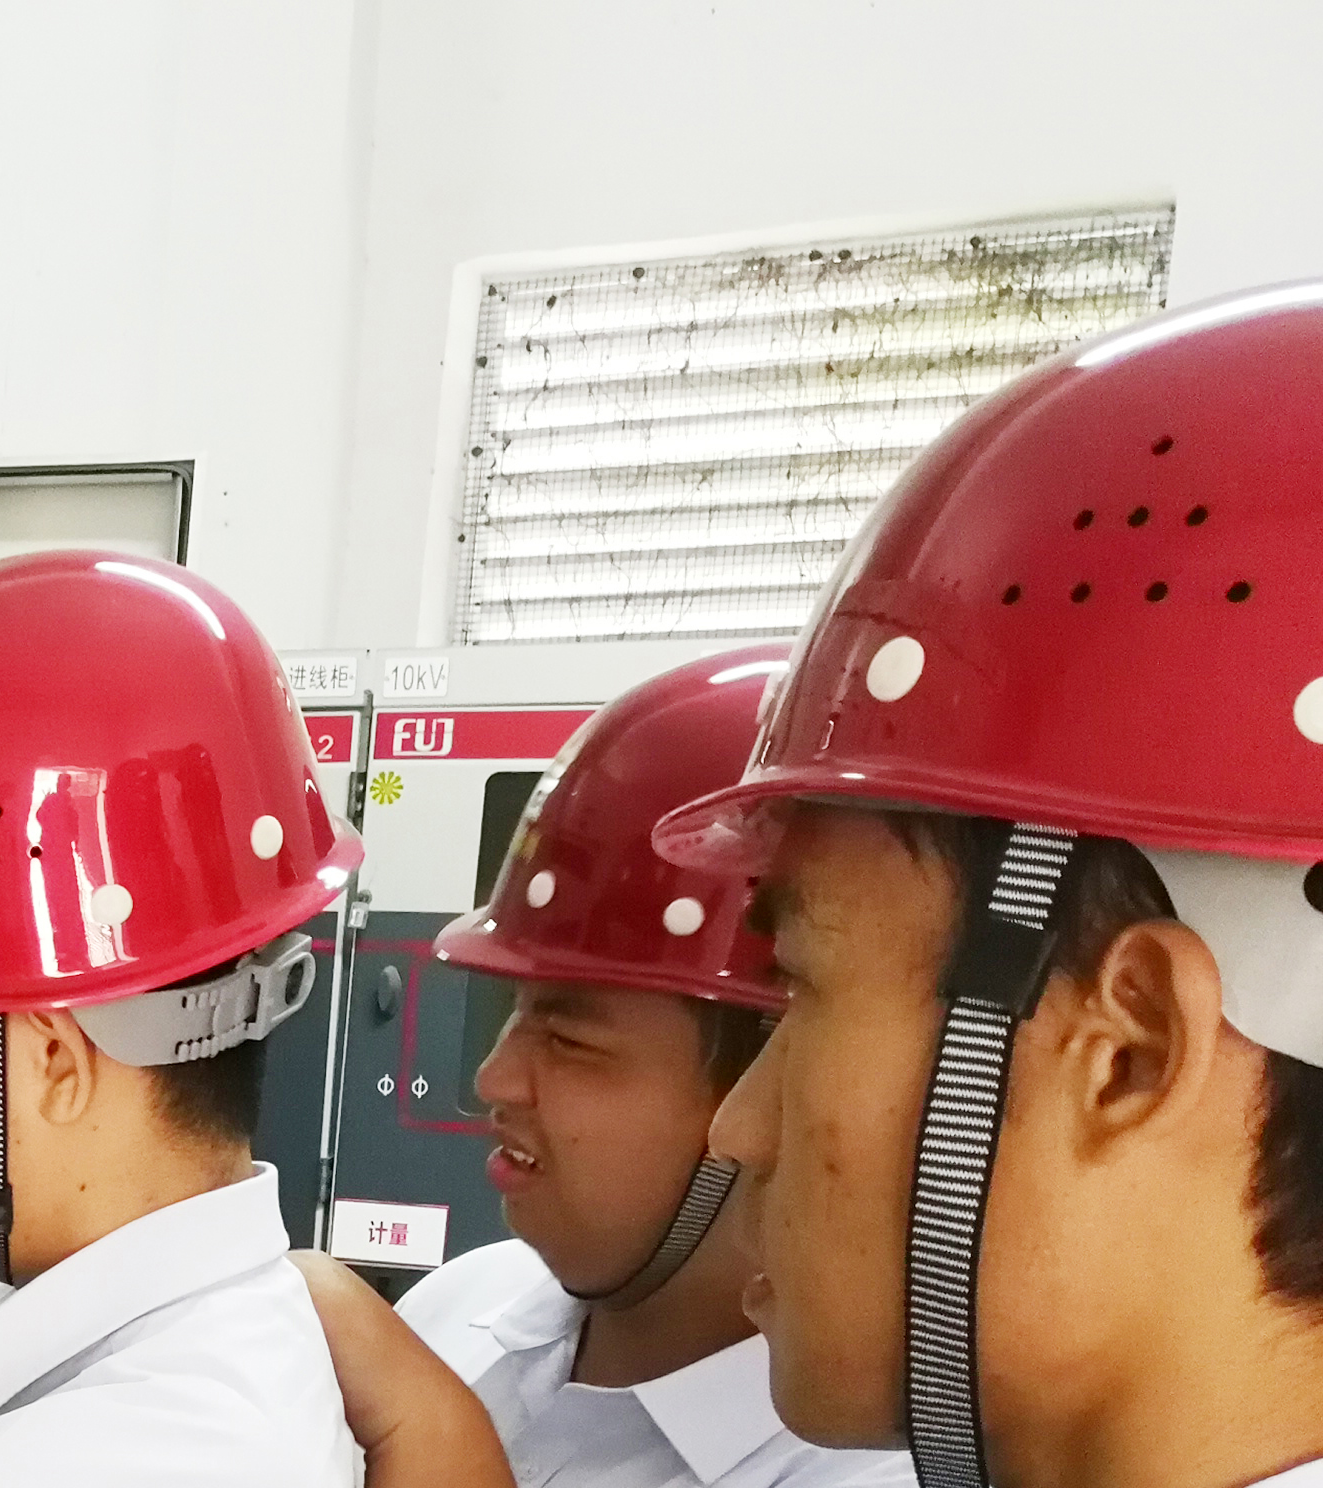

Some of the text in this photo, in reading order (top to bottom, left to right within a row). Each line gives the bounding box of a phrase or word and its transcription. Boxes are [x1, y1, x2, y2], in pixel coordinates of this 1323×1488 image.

[289, 664, 349, 690] 进线柜
[391, 663, 445, 691] 10kV
[368, 1220, 409, 1247] 计量
